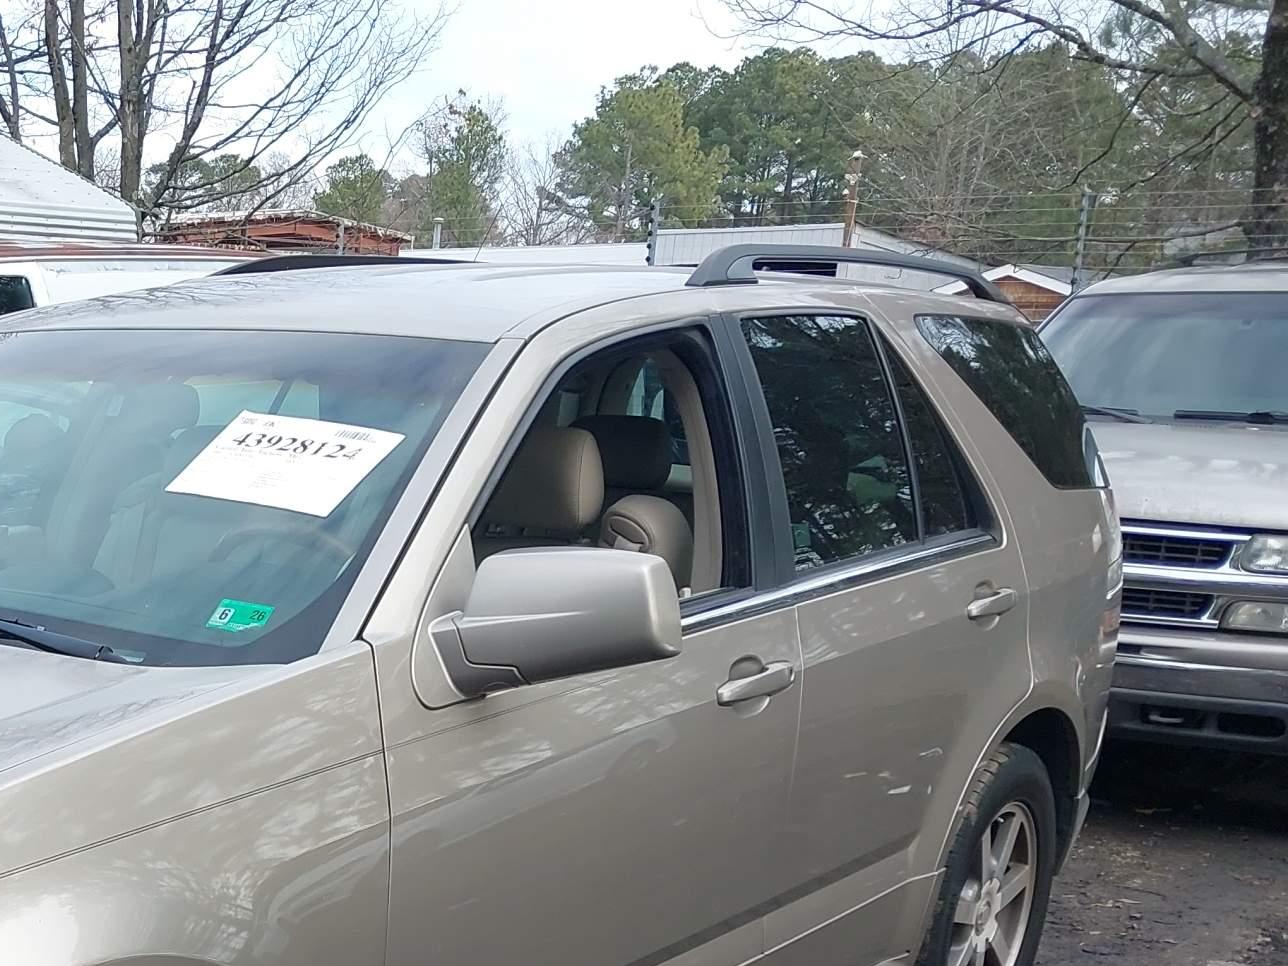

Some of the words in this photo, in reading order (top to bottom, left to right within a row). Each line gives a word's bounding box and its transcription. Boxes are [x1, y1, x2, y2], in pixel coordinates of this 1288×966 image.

[232, 431, 363, 461] 43928124
[218, 608, 232, 621] 6
[248, 610, 267, 622] 26
